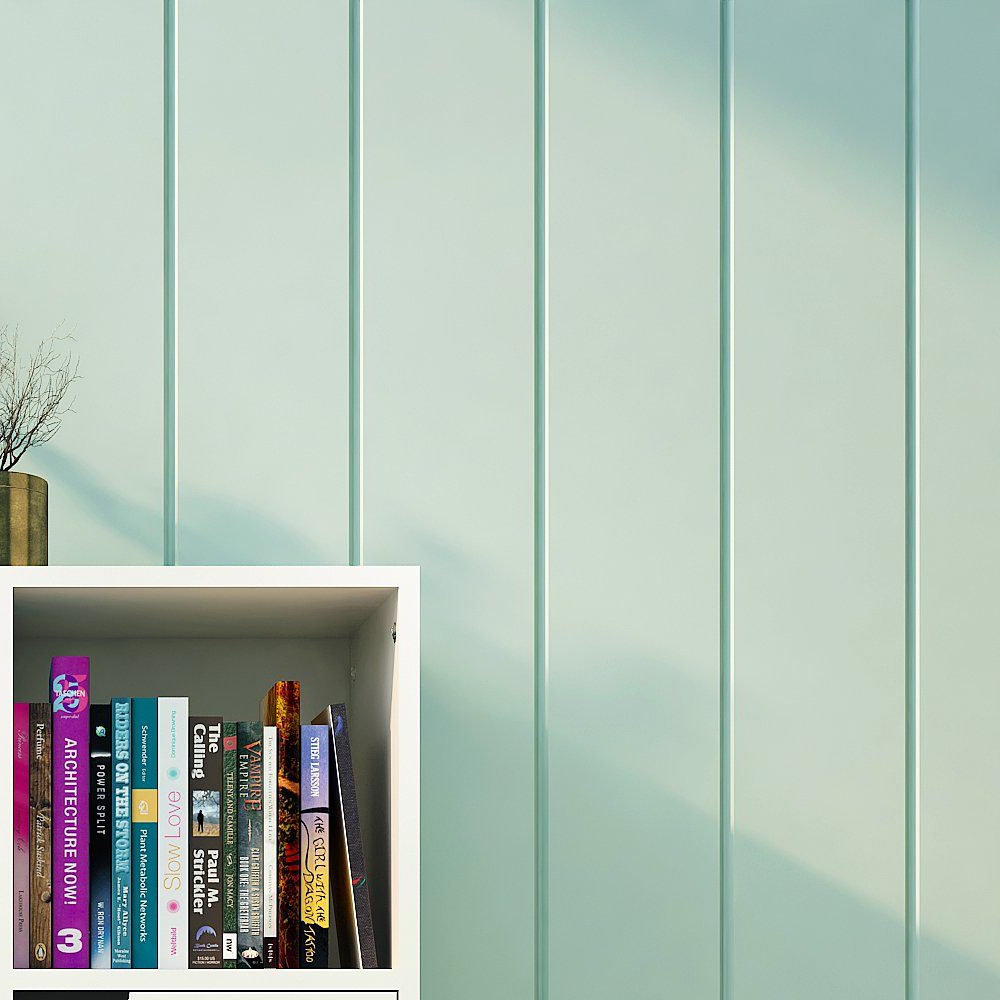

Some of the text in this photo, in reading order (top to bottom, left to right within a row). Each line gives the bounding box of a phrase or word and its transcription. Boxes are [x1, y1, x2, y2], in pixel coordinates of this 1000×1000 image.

[55, 689, 86, 697] TASCHEN
[36, 723, 45, 760] Perfume
[141, 725, 149, 766] Schwender
[191, 723, 206, 779] Calling
[208, 723, 221, 753] The
[240, 754, 249, 798] EMPIRE
[243, 739, 262, 811] VAMPIRE
[310, 737, 320, 797] STIEG LARSSON
[96, 764, 106, 836] POWER SPLIT
[115, 702, 130, 873] RIDERS ON THE STORM
[64, 737, 78, 905] ARCHITECTURE NOW!
[226, 799, 234, 815] AND
[36, 815, 45, 843] Patrick
[226, 816, 234, 845] CAMILLE
[193, 849, 205, 914] Strickler
[207, 849, 220, 908] Paul M.
[239, 856, 249, 872] BOOK
[251, 862, 260, 886] GRIFFITH
[312, 816, 326, 922] THE GIRL WITH THE
[121, 886, 129, 908] Mary
[139, 829, 148, 942] Plant Metabolic Networks
[226, 874, 234, 908] JON MACY
[239, 889, 249, 900] THE
[56, 928, 83, 954] 3
[251, 911, 260, 936] GRIFFITH
